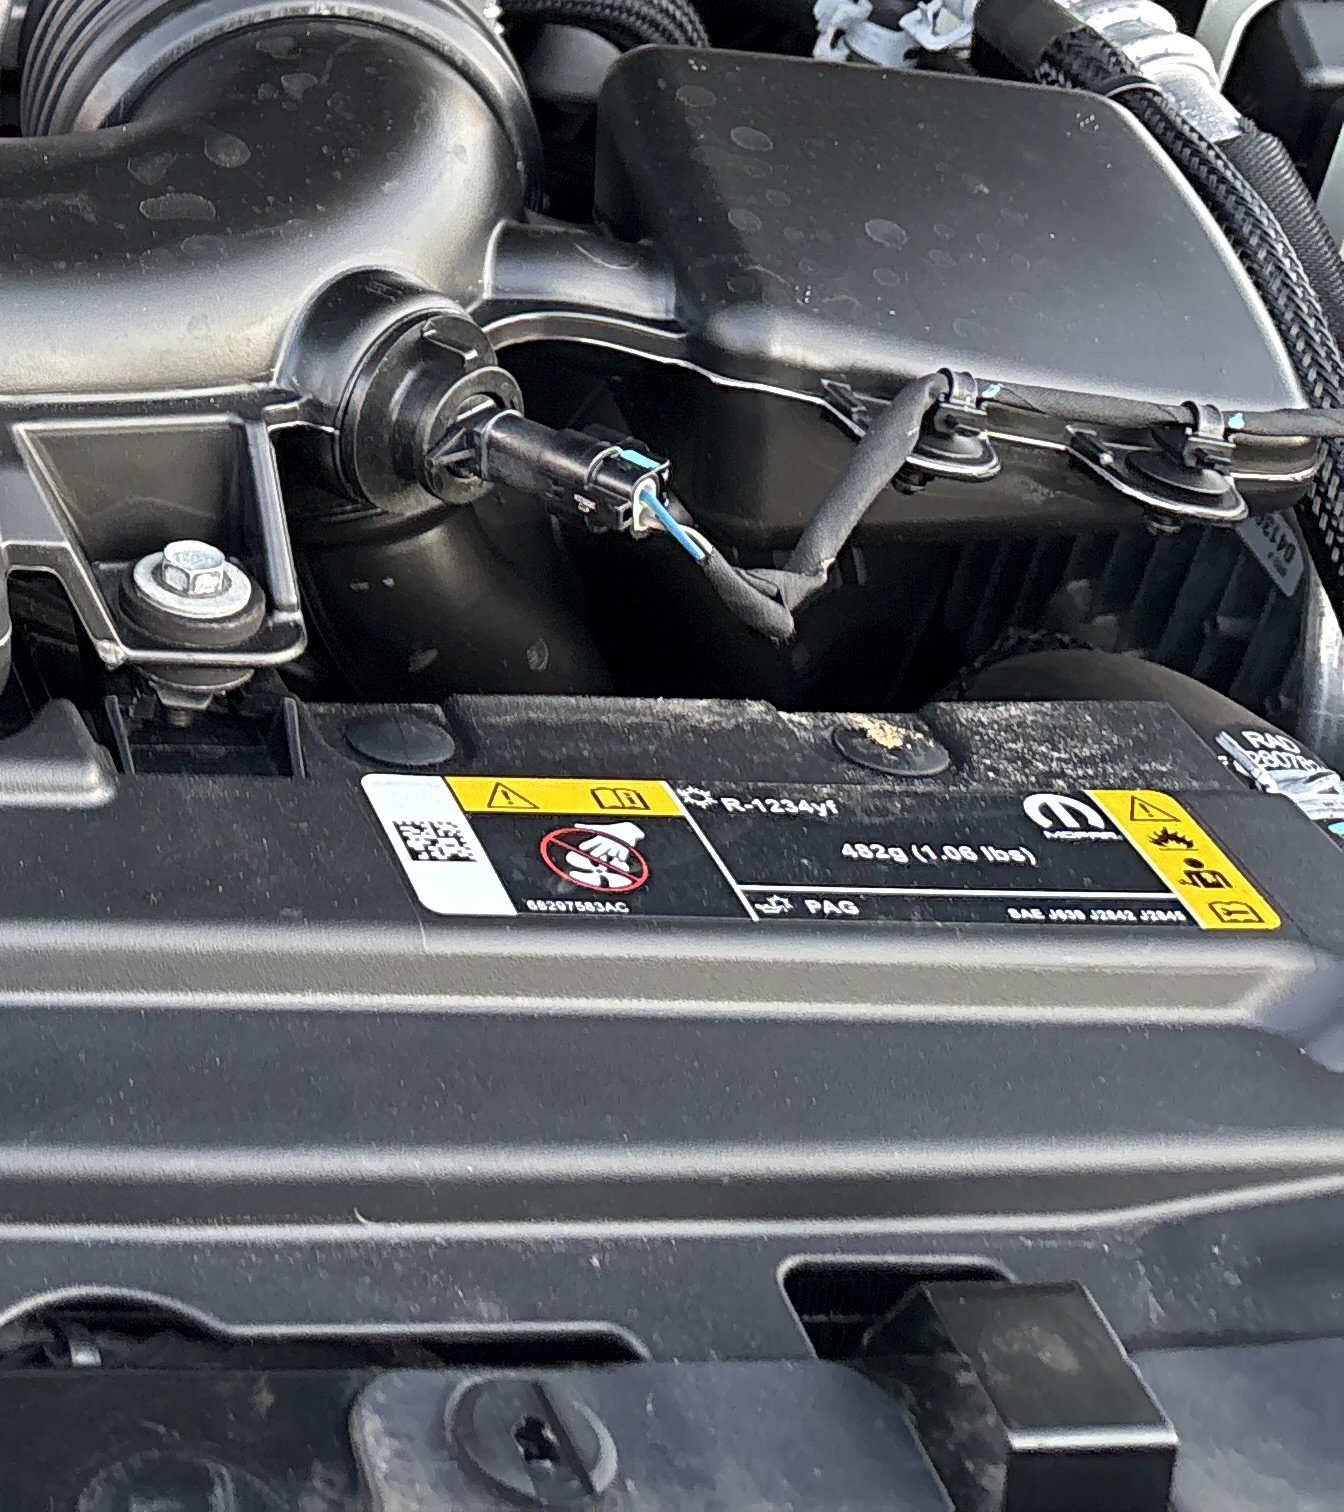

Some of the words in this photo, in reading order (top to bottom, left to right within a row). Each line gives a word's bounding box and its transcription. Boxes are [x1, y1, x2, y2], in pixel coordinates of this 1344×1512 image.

[1241, 730, 1301, 755] RAD
[719, 796, 839, 818] R-1234yf
[841, 842, 910, 864] 482g
[979, 845, 1037, 867] lbs)
[804, 899, 860, 915] PAG
[1007, 907, 1046, 920] SAE
